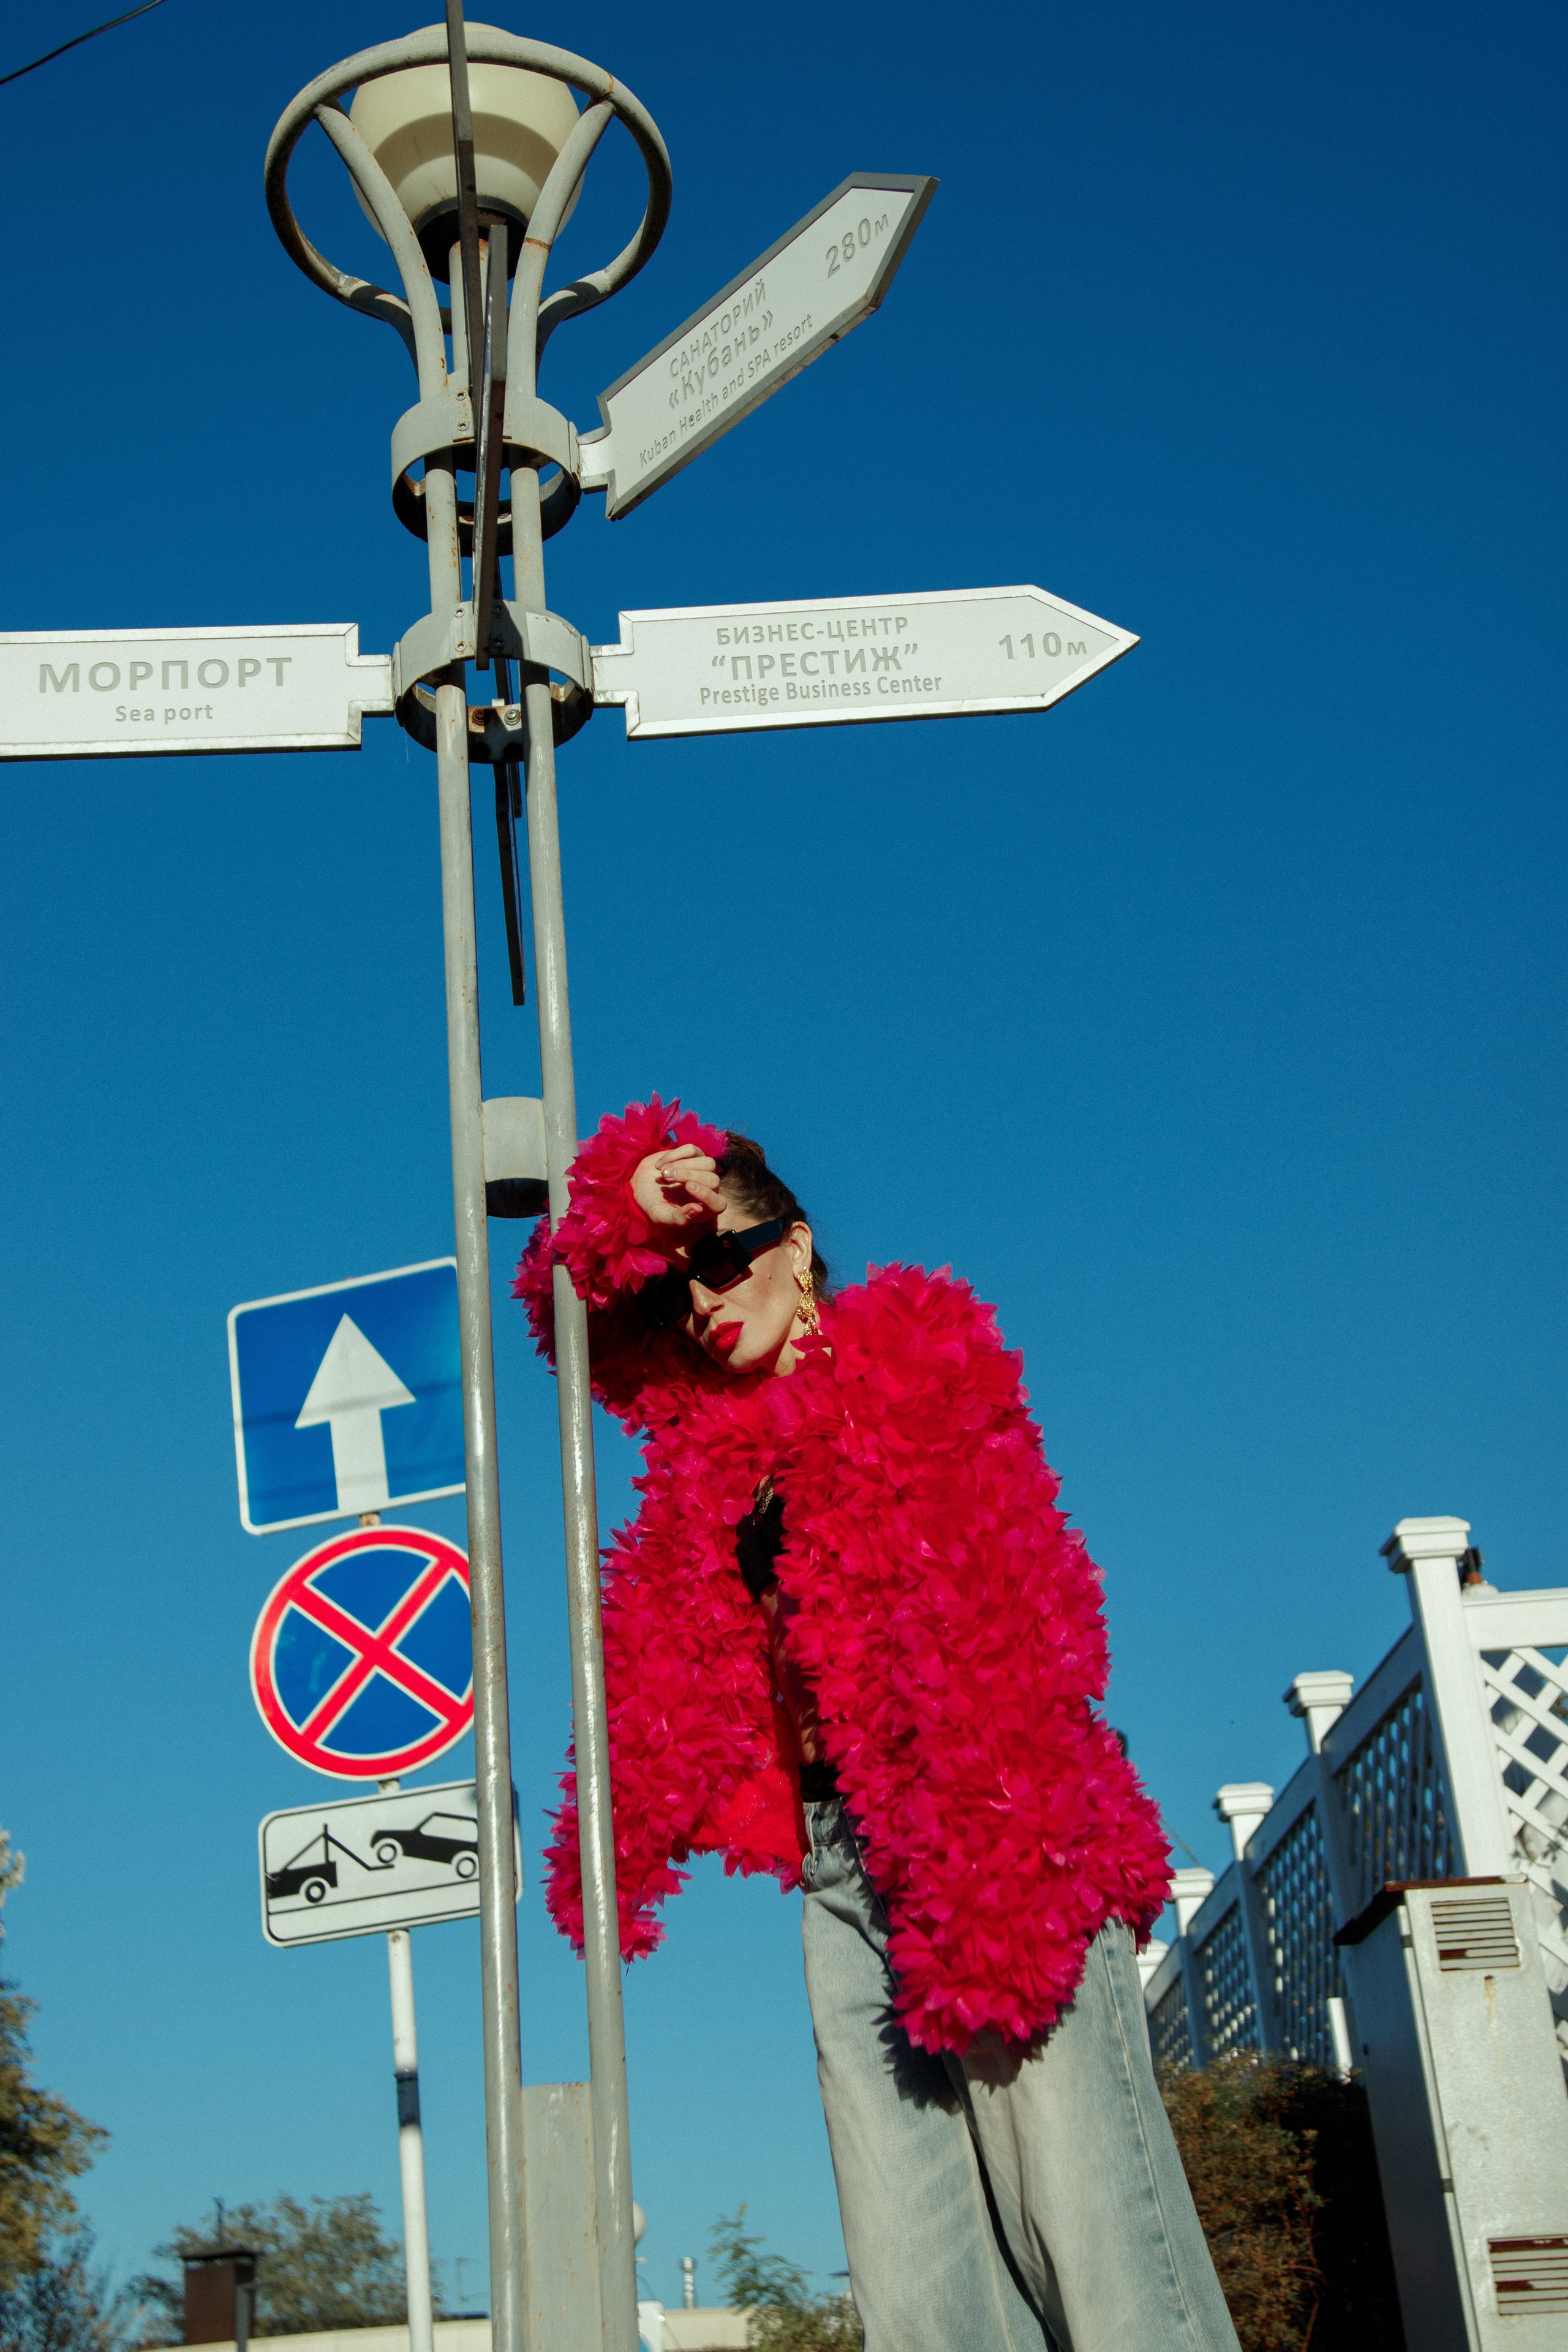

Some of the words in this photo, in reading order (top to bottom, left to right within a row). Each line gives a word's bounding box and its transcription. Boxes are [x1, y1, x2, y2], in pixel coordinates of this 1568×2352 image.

[669, 278, 767, 379] САНАТОРИЙ
[668, 311, 774, 410] «Кубань»
[639, 431, 676, 468] Kuban
[679, 392, 719, 434] Health
[722, 368, 745, 400] and
[747, 348, 771, 379] SPA
[774, 313, 813, 356] resort
[716, 617, 909, 646] БИЗНЕС-ЦЕНТР
[39, 657, 292, 693] МОРПОРТ
[700, 681, 780, 706] Prestige
[786, 677, 871, 700] Business
[876, 674, 942, 694] Center
[115, 706, 156, 722] Sea
[164, 704, 214, 725] port
